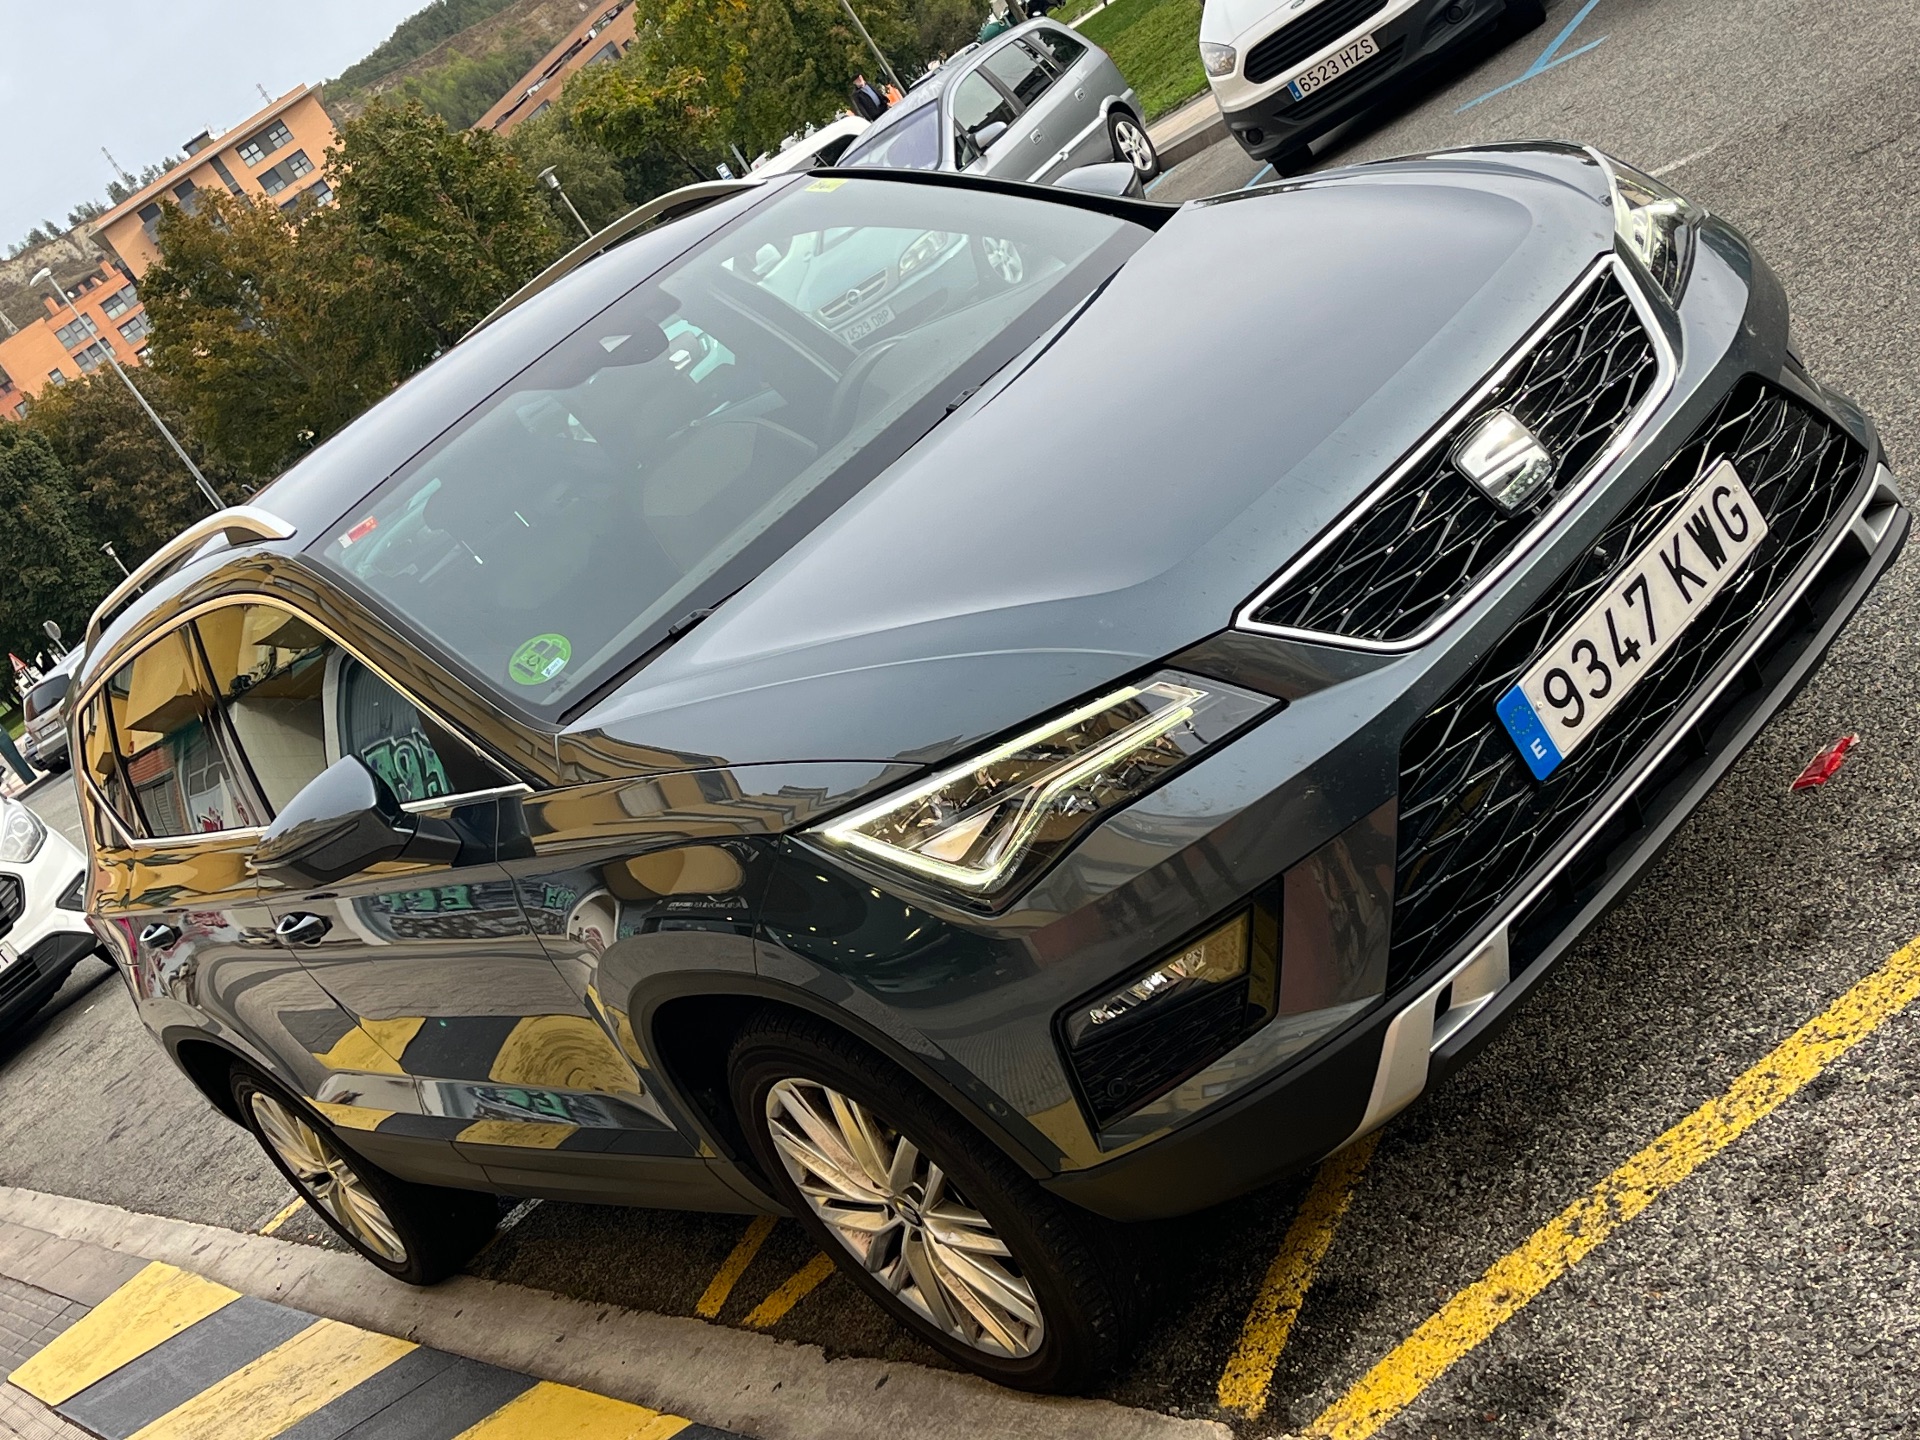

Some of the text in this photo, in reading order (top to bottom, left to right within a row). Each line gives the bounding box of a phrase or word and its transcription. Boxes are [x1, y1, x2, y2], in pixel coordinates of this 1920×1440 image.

[1299, 60, 1339, 92] 6523
[1339, 39, 1373, 67] HZS
[1530, 486, 1748, 760] E 9347 KWG
